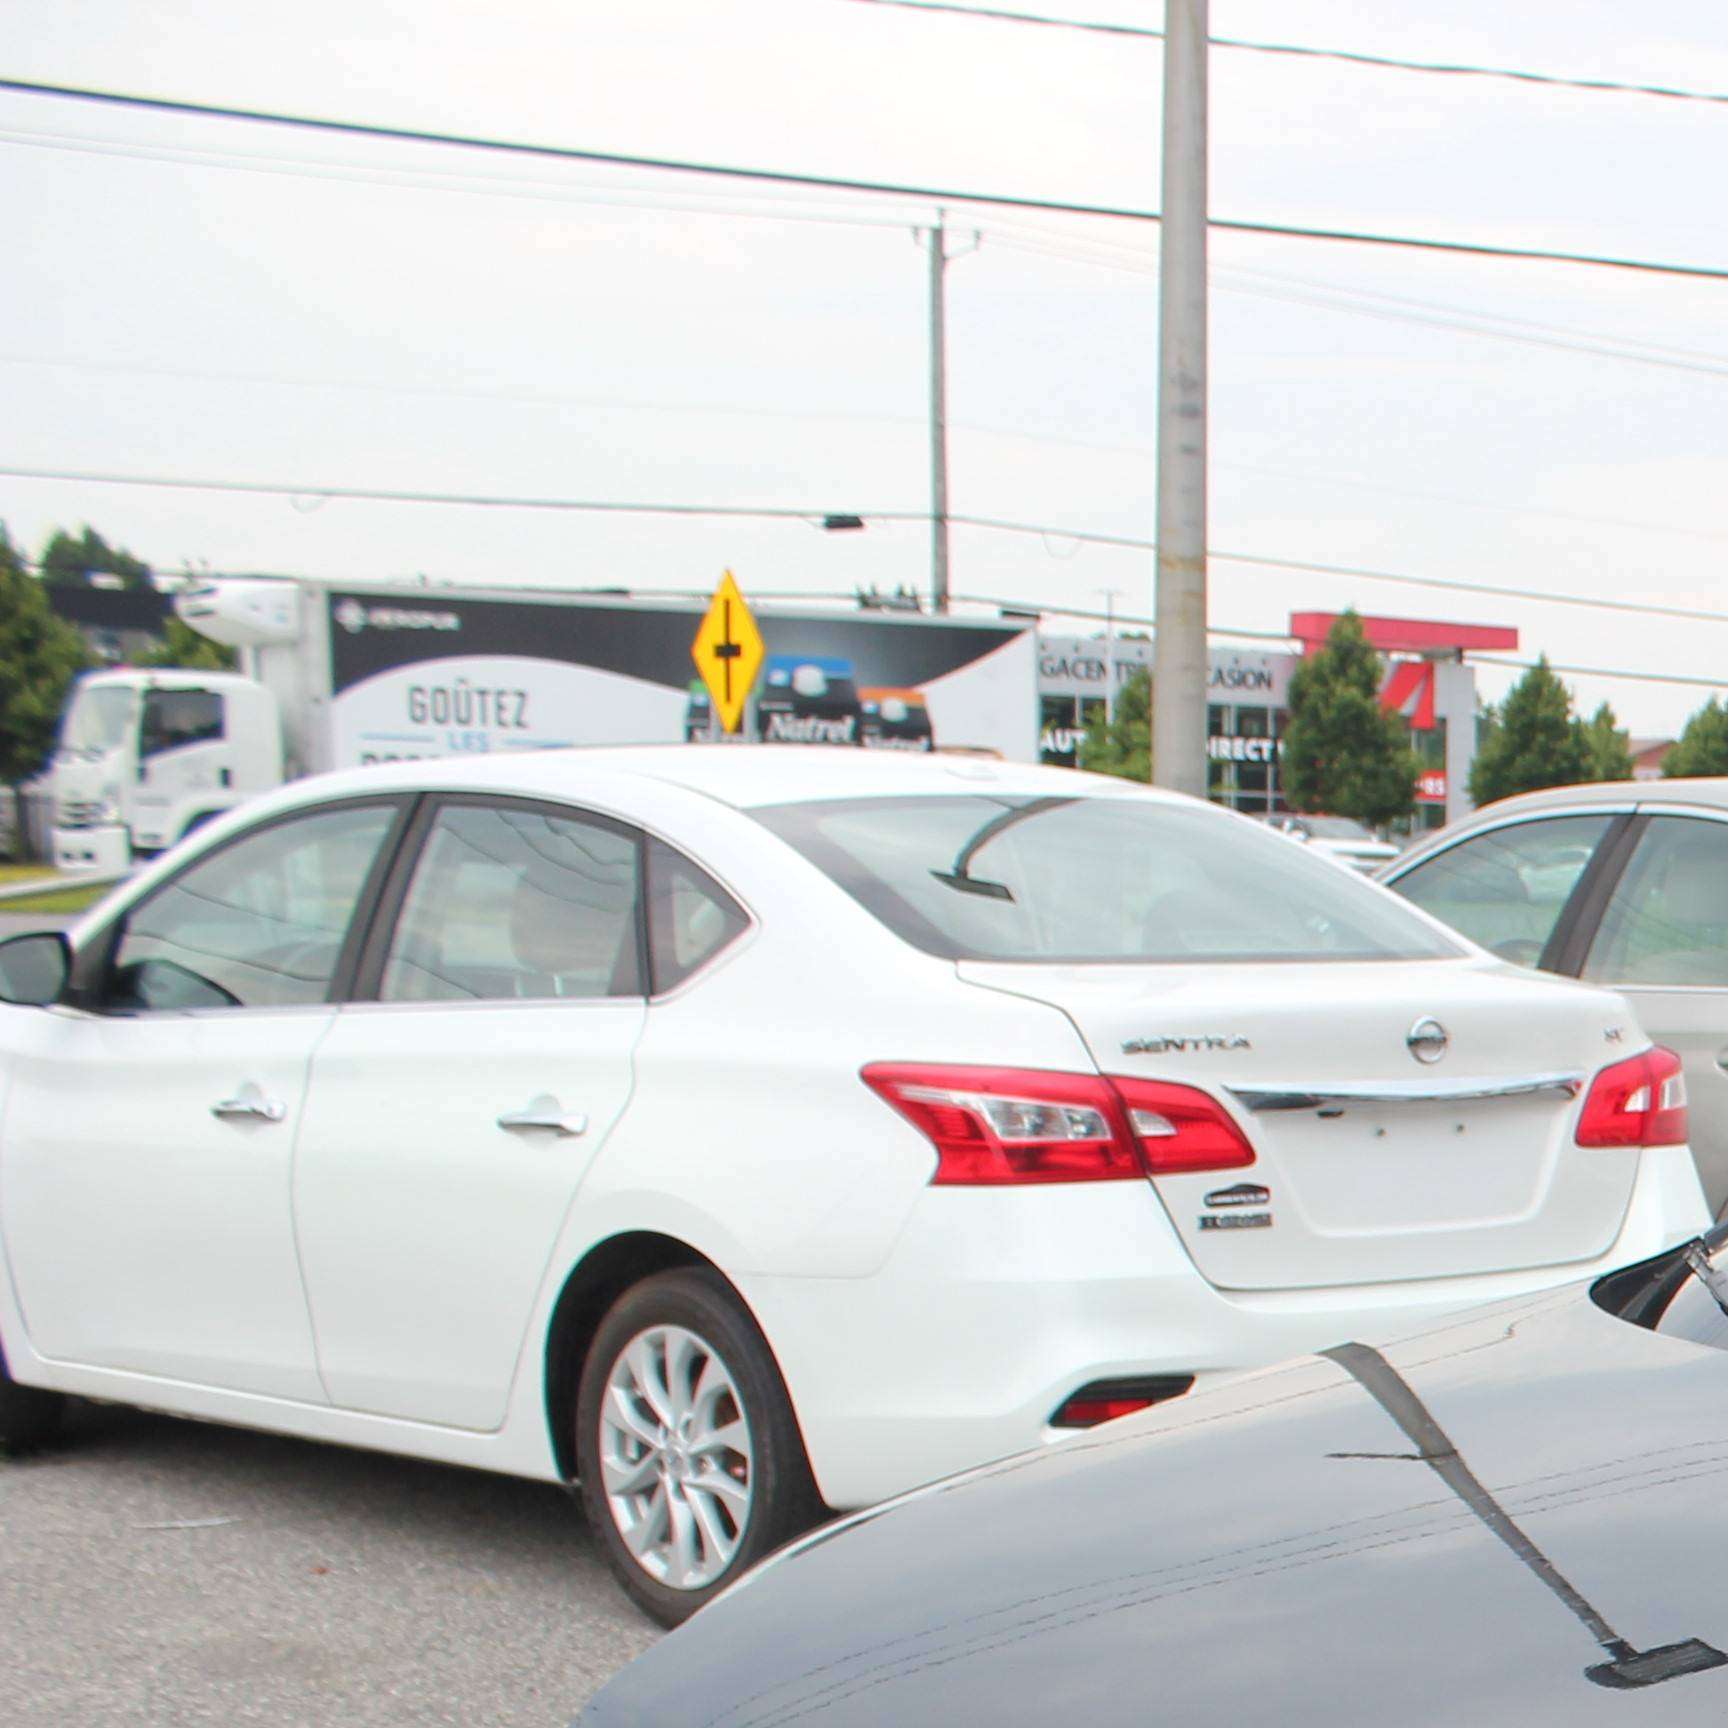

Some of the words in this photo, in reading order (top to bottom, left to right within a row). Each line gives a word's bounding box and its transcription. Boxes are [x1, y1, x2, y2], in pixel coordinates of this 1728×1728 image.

[408, 677, 528, 729] GOÛTEZ
[1040, 728, 1087, 753] AUT
[1207, 736, 1272, 763] IRECT
[1120, 1035, 1252, 1055] SENTRA
